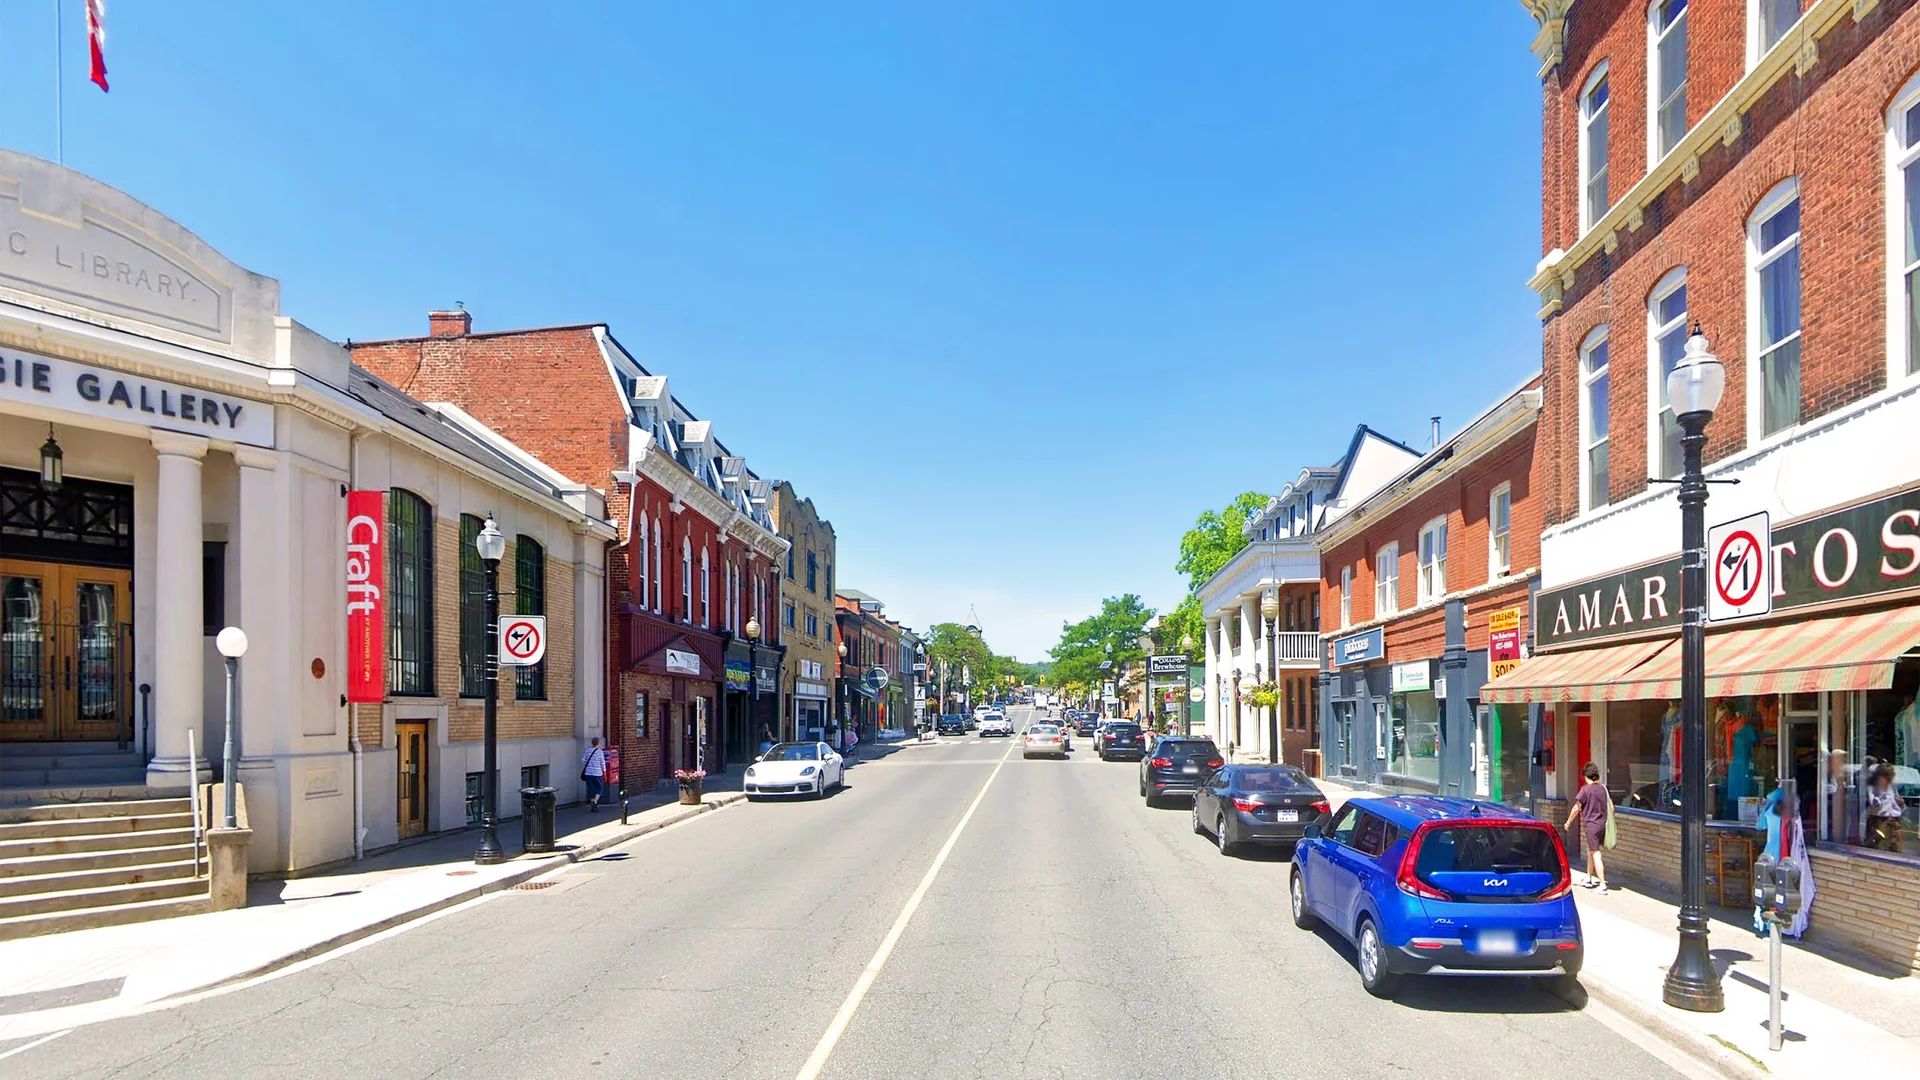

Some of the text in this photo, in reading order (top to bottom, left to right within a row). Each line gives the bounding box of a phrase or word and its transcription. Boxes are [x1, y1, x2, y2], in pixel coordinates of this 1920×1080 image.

[76, 373, 244, 429] GALLERY
[347, 514, 380, 616] Craft
[1483, 878, 1508, 887] KIA
